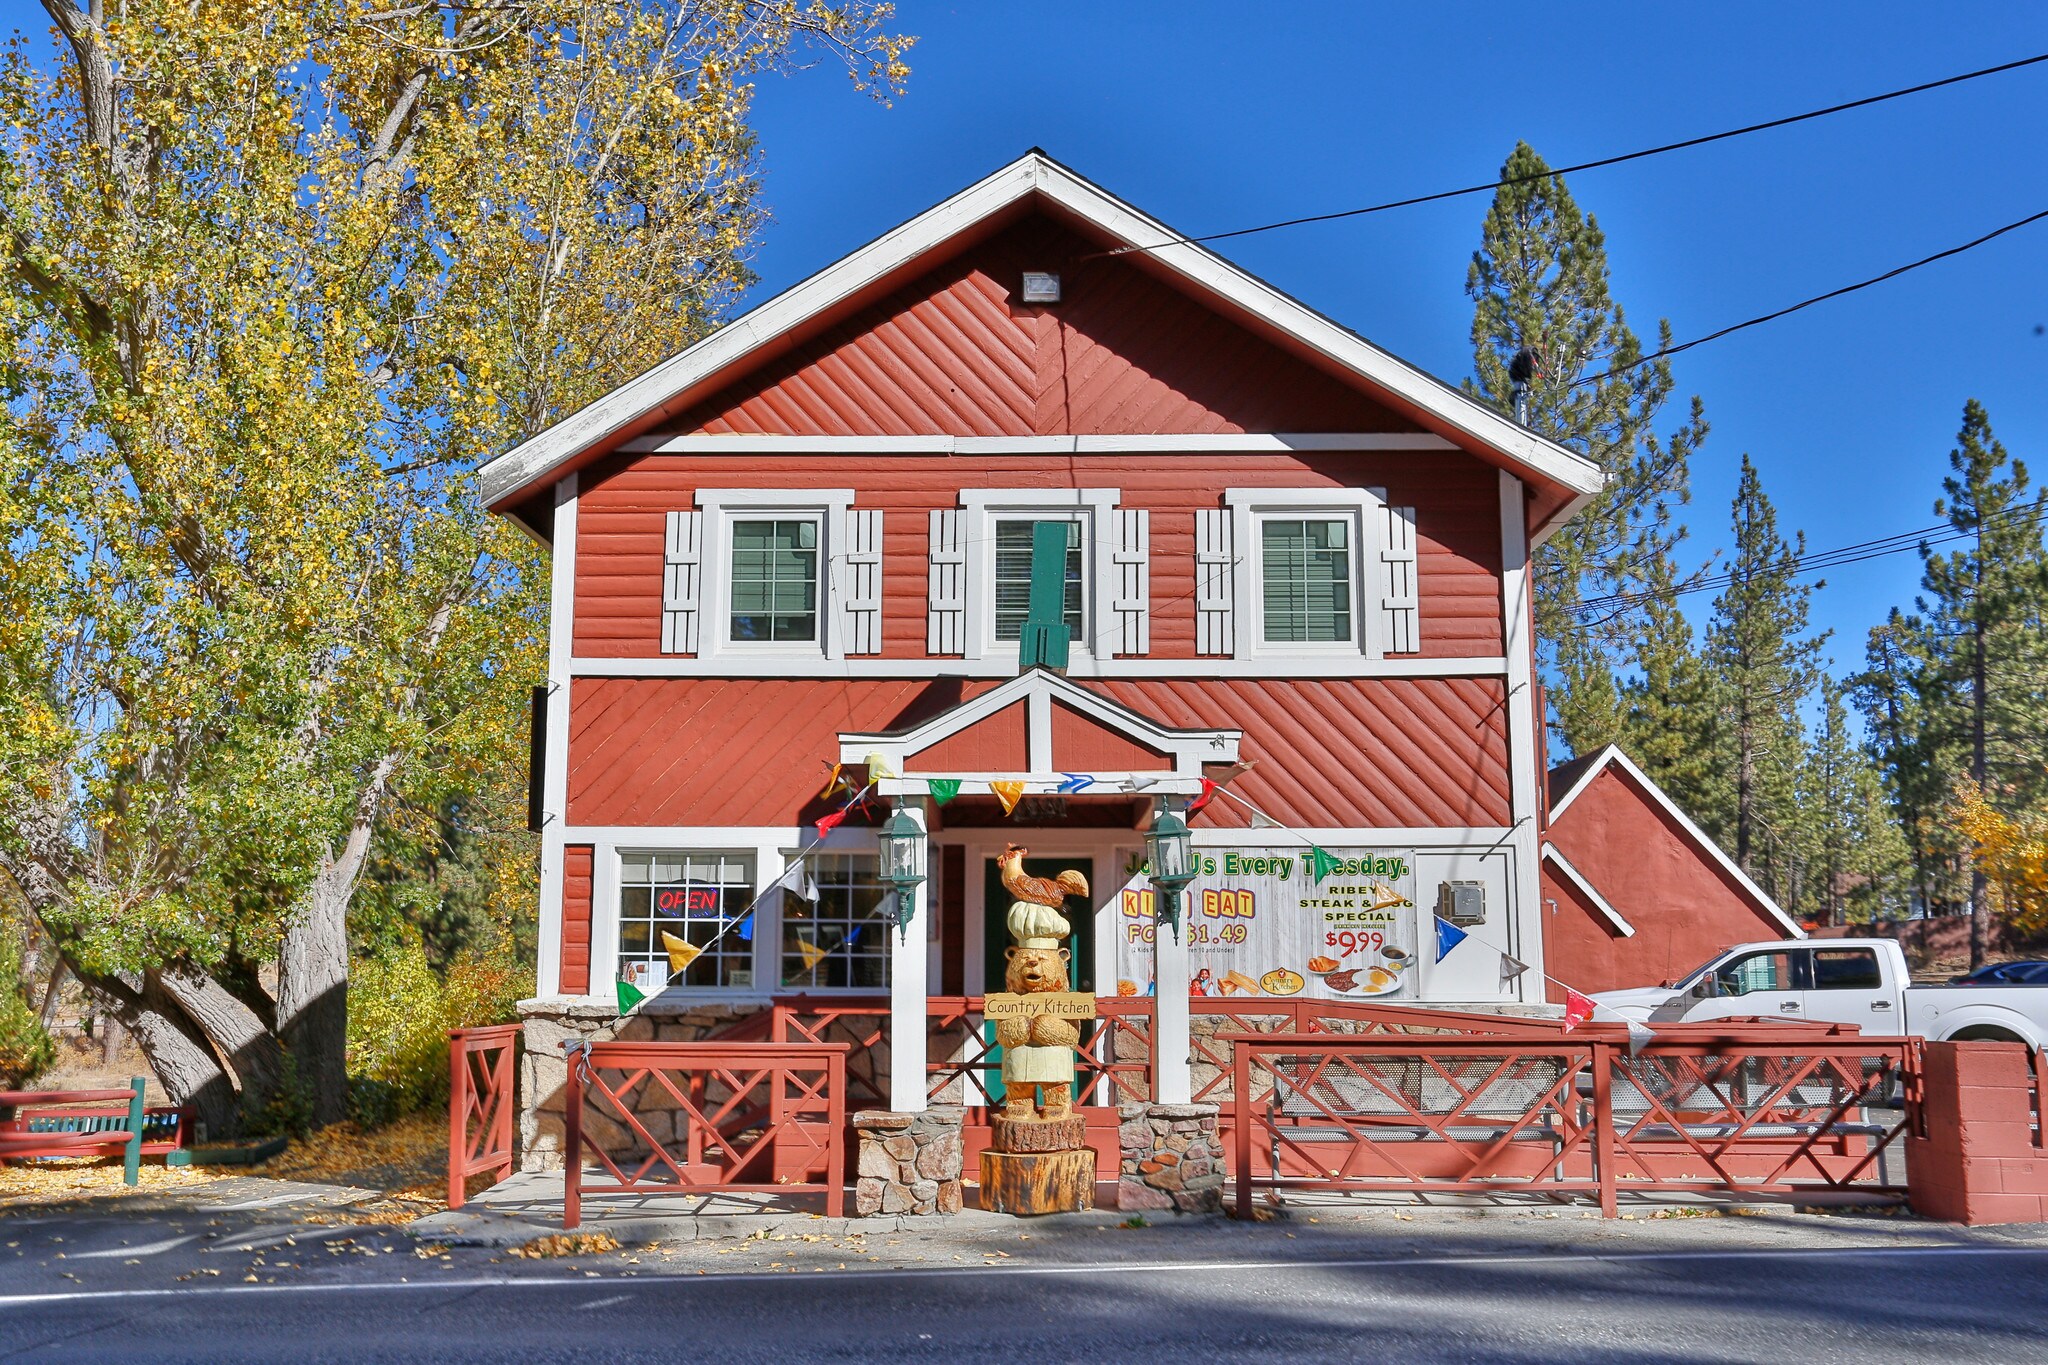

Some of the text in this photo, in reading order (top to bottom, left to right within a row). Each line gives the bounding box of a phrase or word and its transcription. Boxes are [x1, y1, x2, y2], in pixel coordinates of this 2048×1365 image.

[1186, 852, 1217, 876] Us
[1223, 852, 1294, 881] Every
[1300, 853, 1409, 881] Tesday.
[659, 891, 717, 909] OPEN
[1329, 886, 1378, 895] RIBEY
[1203, 890, 1253, 917] EAT
[1300, 899, 1354, 908] STEAK
[1361, 899, 1372, 908] &
[1325, 912, 1395, 921] SPECIAL
[1187, 922, 1247, 947] $1.49
[1325, 931, 1384, 959] $9.99
[987, 998, 1090, 1017] Country Kitchen
